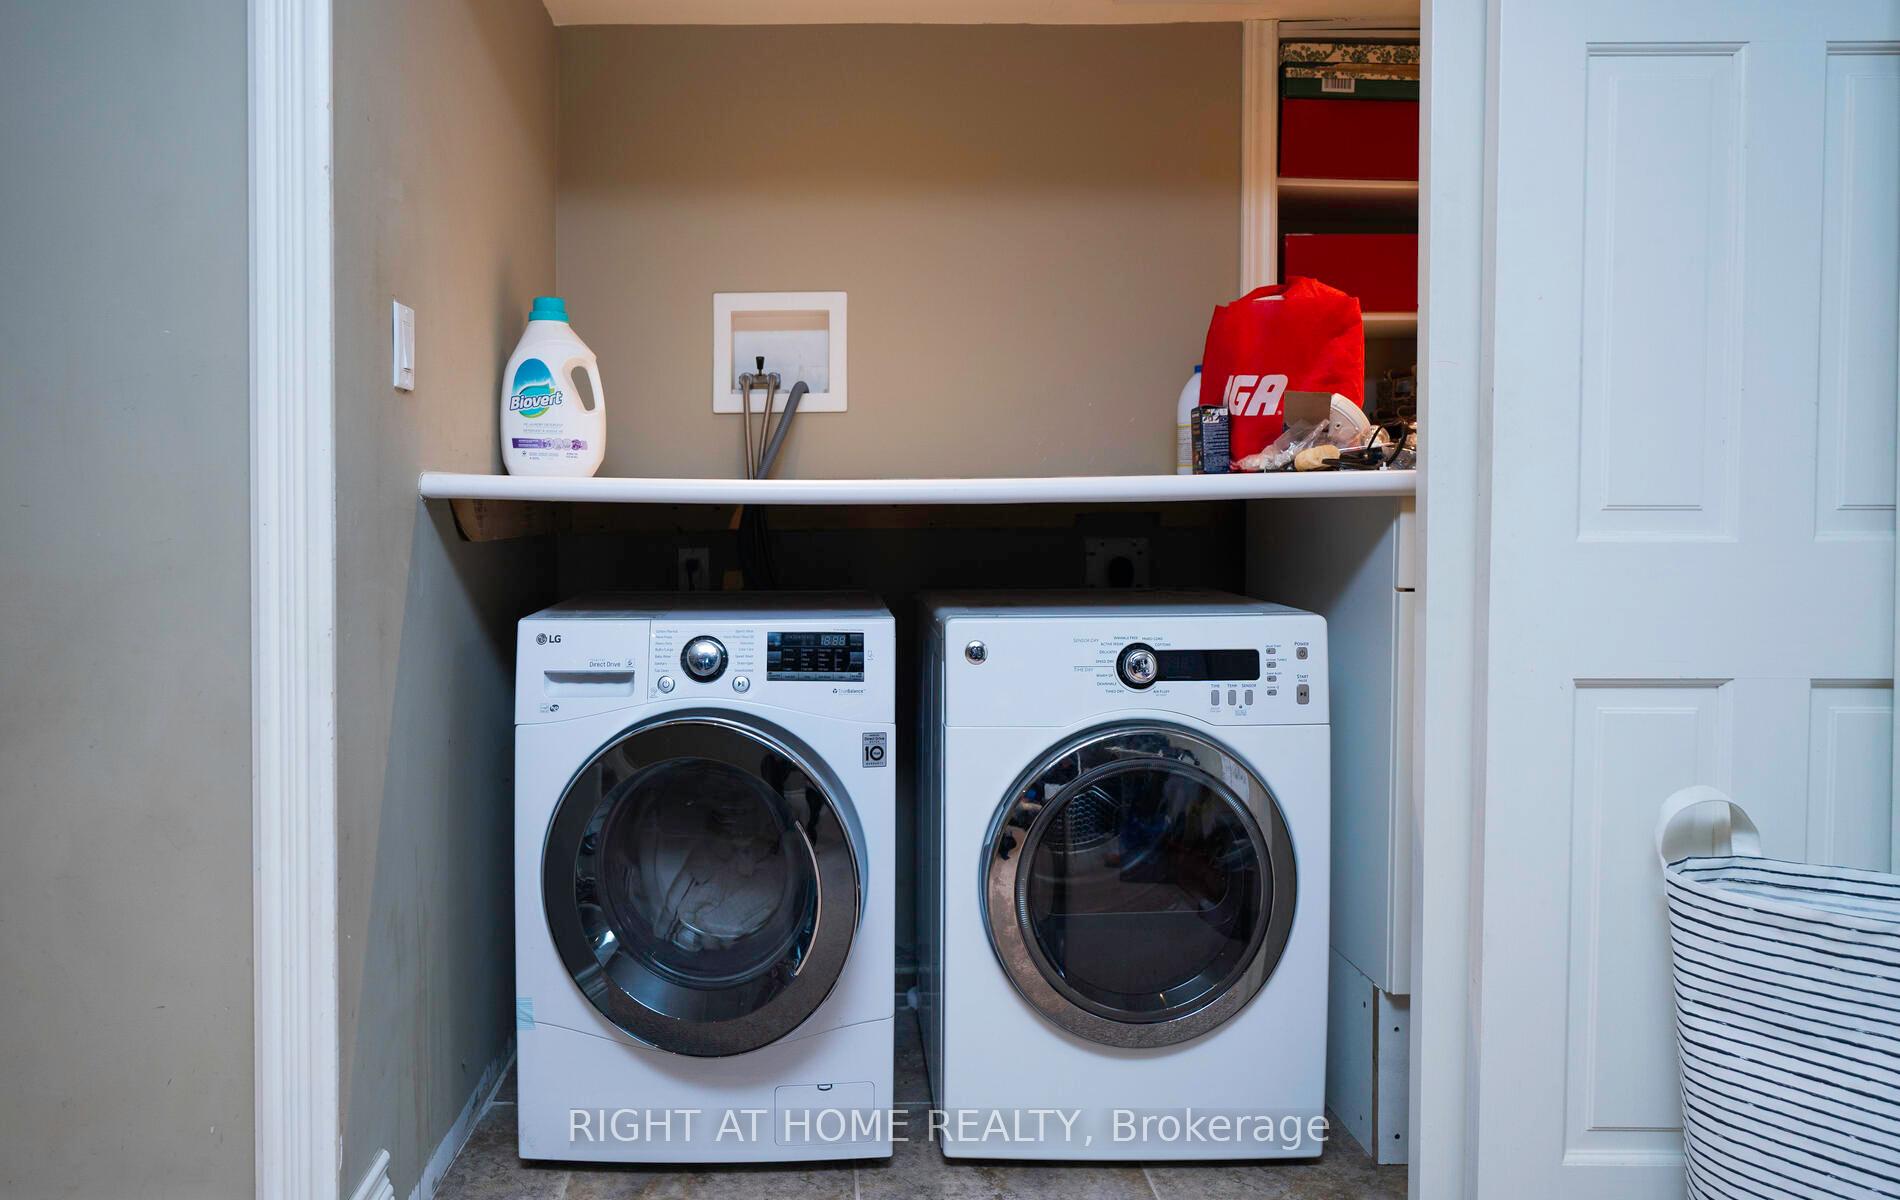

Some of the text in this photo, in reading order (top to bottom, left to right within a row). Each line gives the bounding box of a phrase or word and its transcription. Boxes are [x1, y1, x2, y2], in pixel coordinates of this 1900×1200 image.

[509, 391, 563, 411] Biovert
[1223, 374, 1288, 416] IGA
[549, 635, 561, 643] LG
[865, 745, 884, 761] 10
